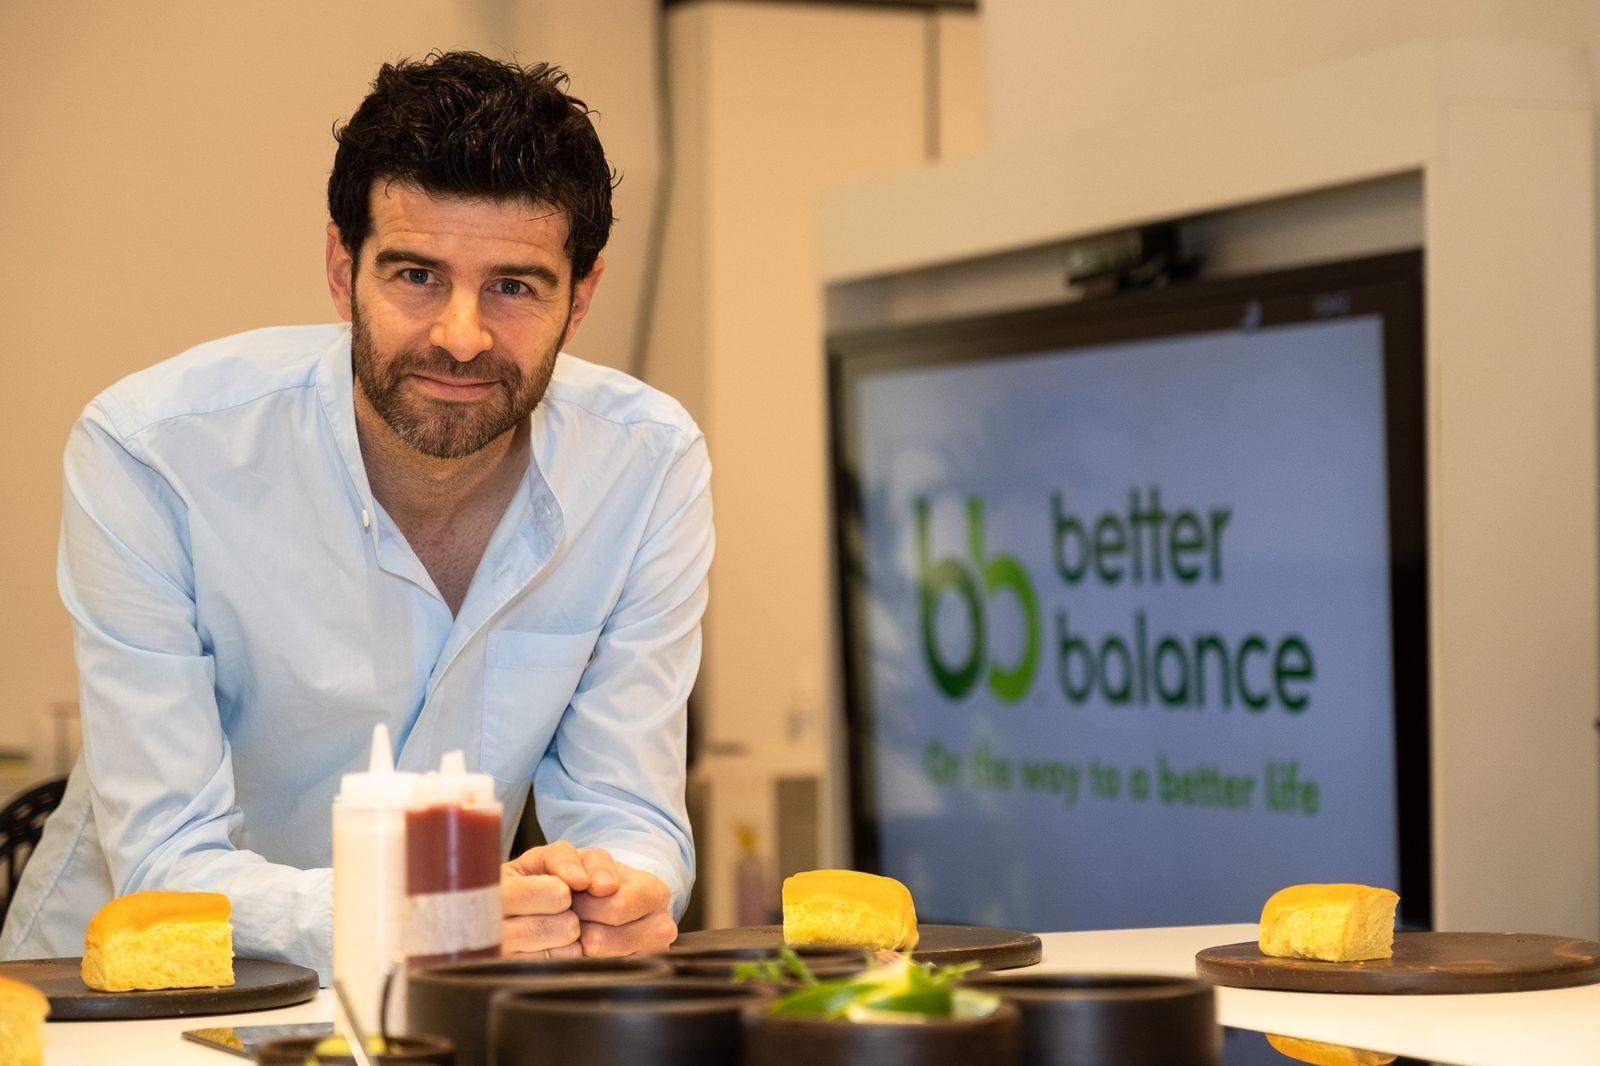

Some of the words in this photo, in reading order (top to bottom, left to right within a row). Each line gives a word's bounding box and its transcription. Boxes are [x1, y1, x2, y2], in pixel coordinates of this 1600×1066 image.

[1051, 486, 1232, 585] better
[1055, 610, 1316, 714] balance
[1021, 760, 1081, 811] way
[1088, 760, 1121, 799] to
[1129, 766, 1150, 802] a
[1155, 752, 1255, 810] better
[1264, 757, 1319, 816] life
